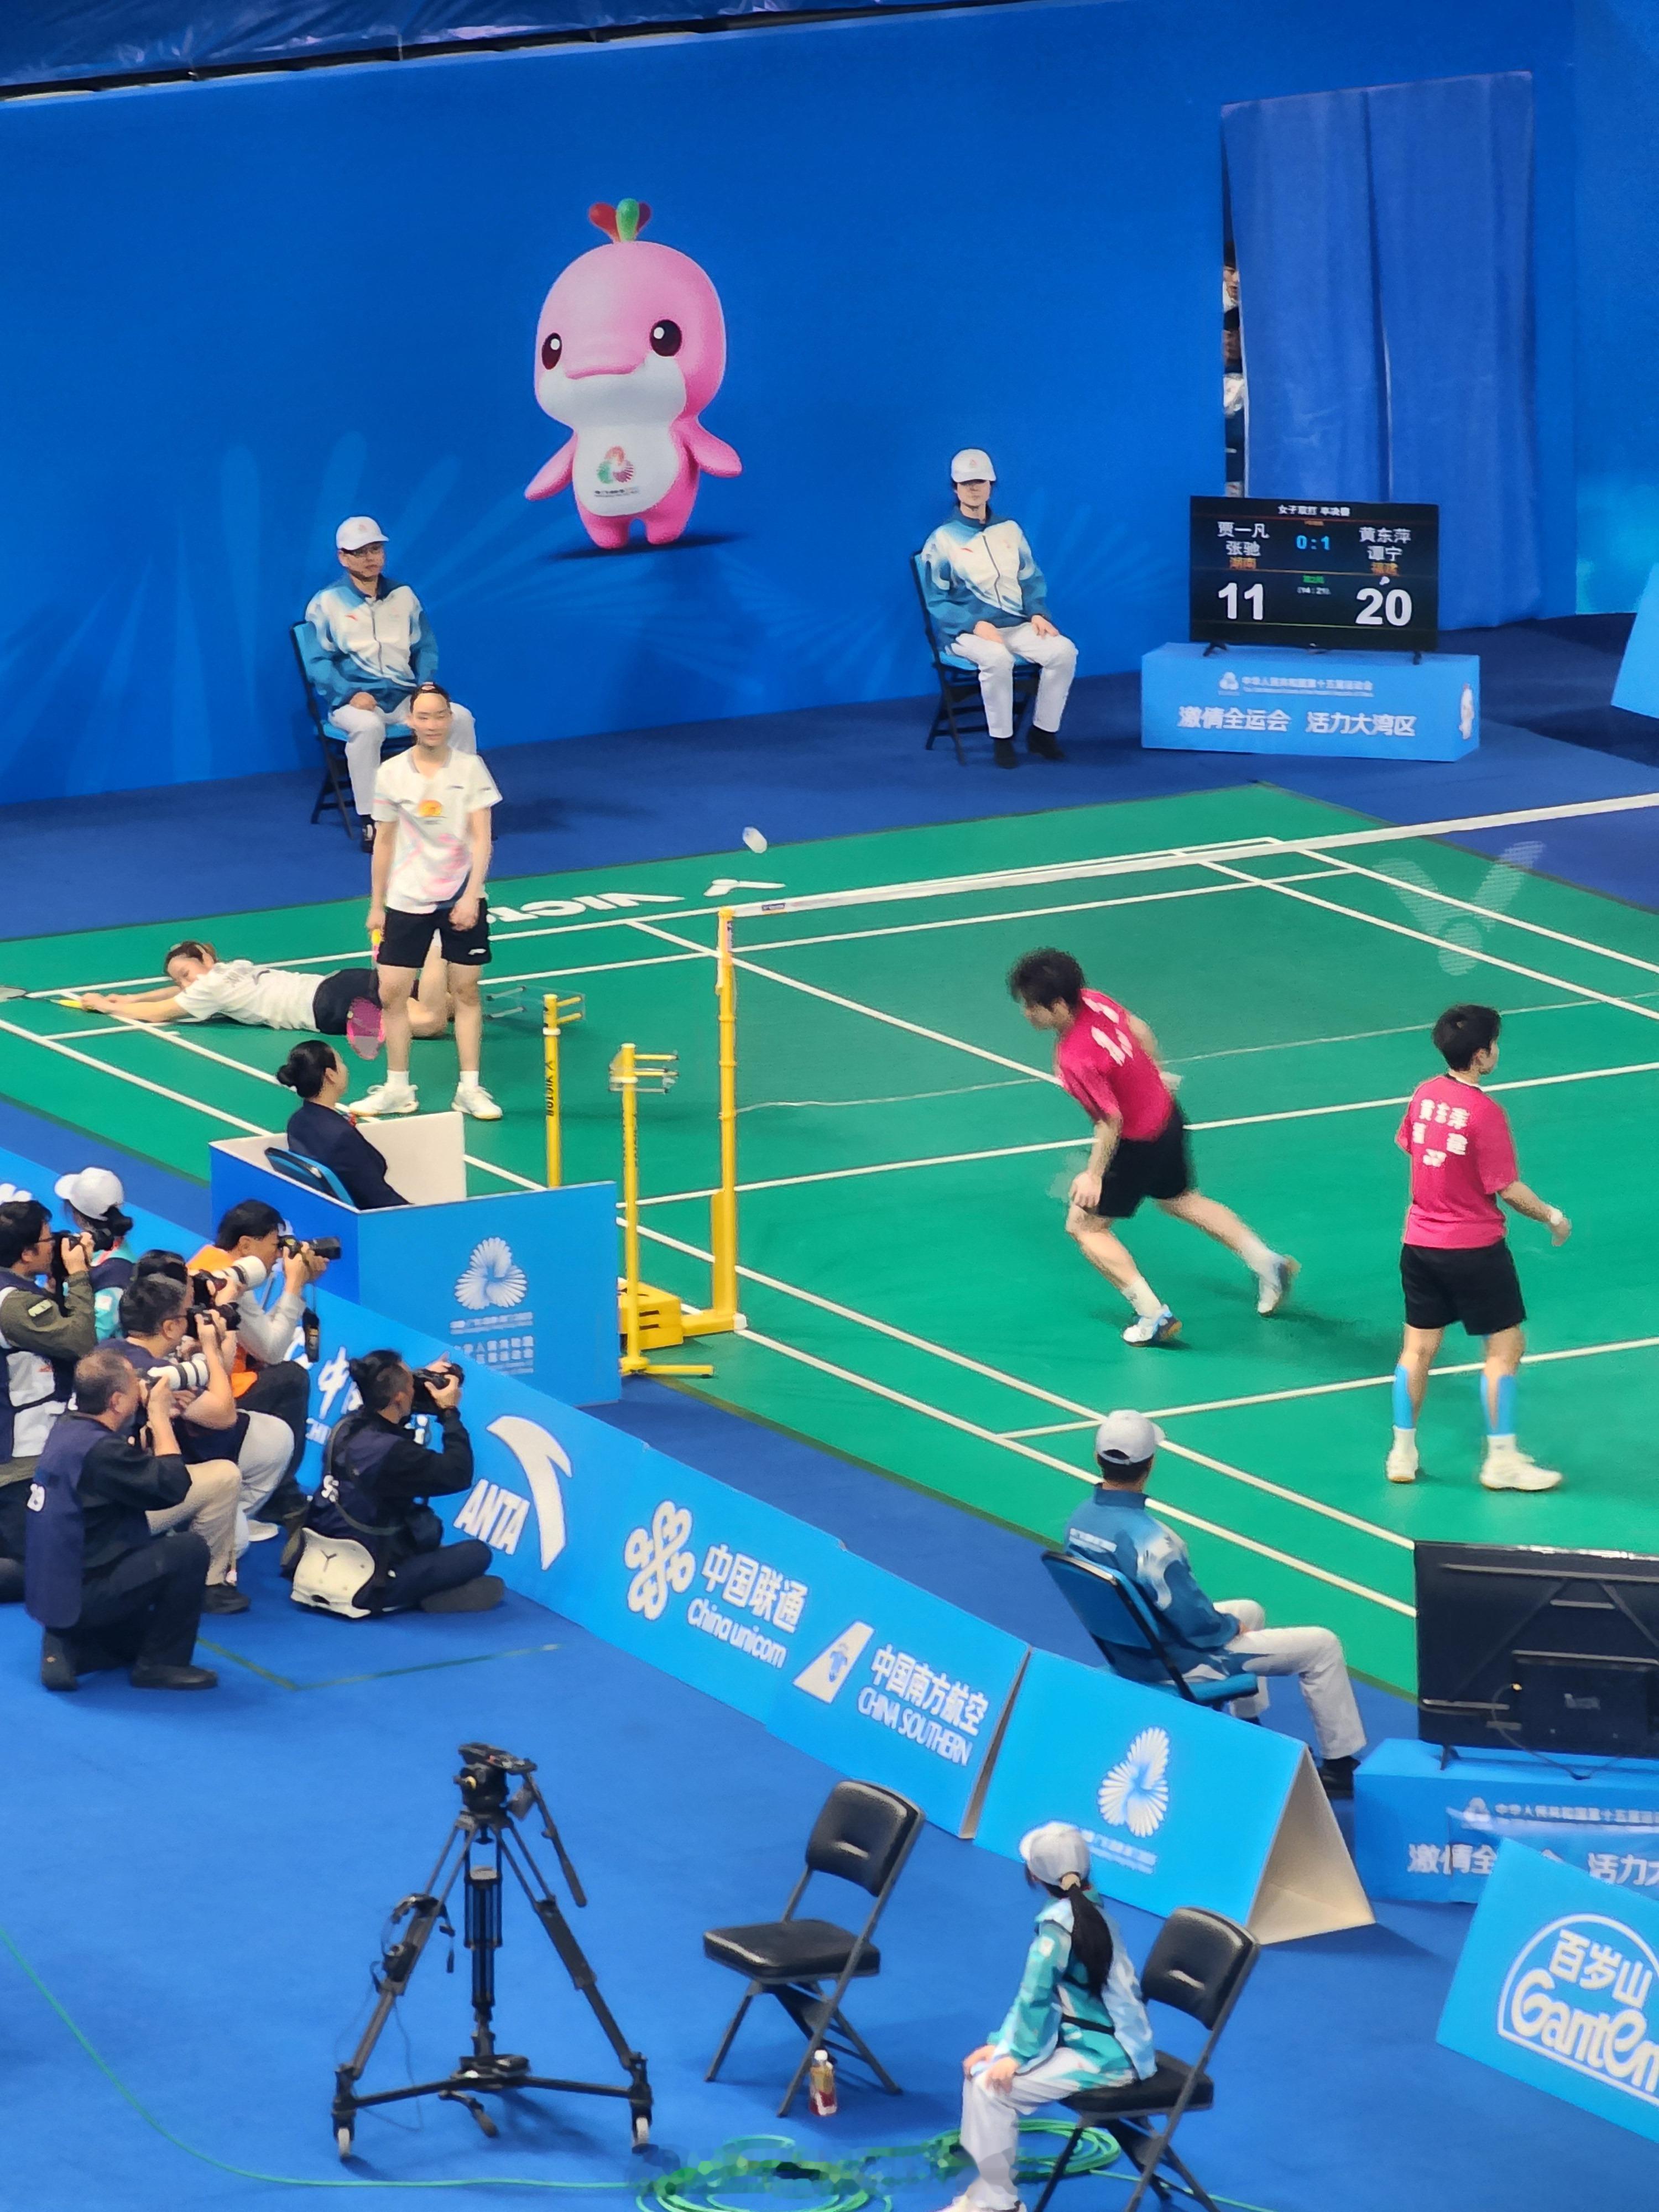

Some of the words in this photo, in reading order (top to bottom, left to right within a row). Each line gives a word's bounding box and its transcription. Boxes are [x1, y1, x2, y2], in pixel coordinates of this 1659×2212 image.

[1217, 521, 1270, 539] 贾一凡
[1359, 526, 1411, 544] 黄东萍
[1218, 582, 1264, 620] 11
[1355, 588, 1413, 626] 20
[1177, 706, 1291, 732] 激情全运会
[1305, 711, 1417, 737] 活力大湾区
[487, 892, 686, 924] VICT
[453, 1479, 530, 1555] ANTA
[702, 1543, 809, 1634] 中国联通
[871, 1644, 989, 1736] 中国南方航空
[858, 1687, 900, 1730] CHINA
[898, 1708, 973, 1766] SOUTHERN
[1549, 1929, 1652, 2009] 百岁山
